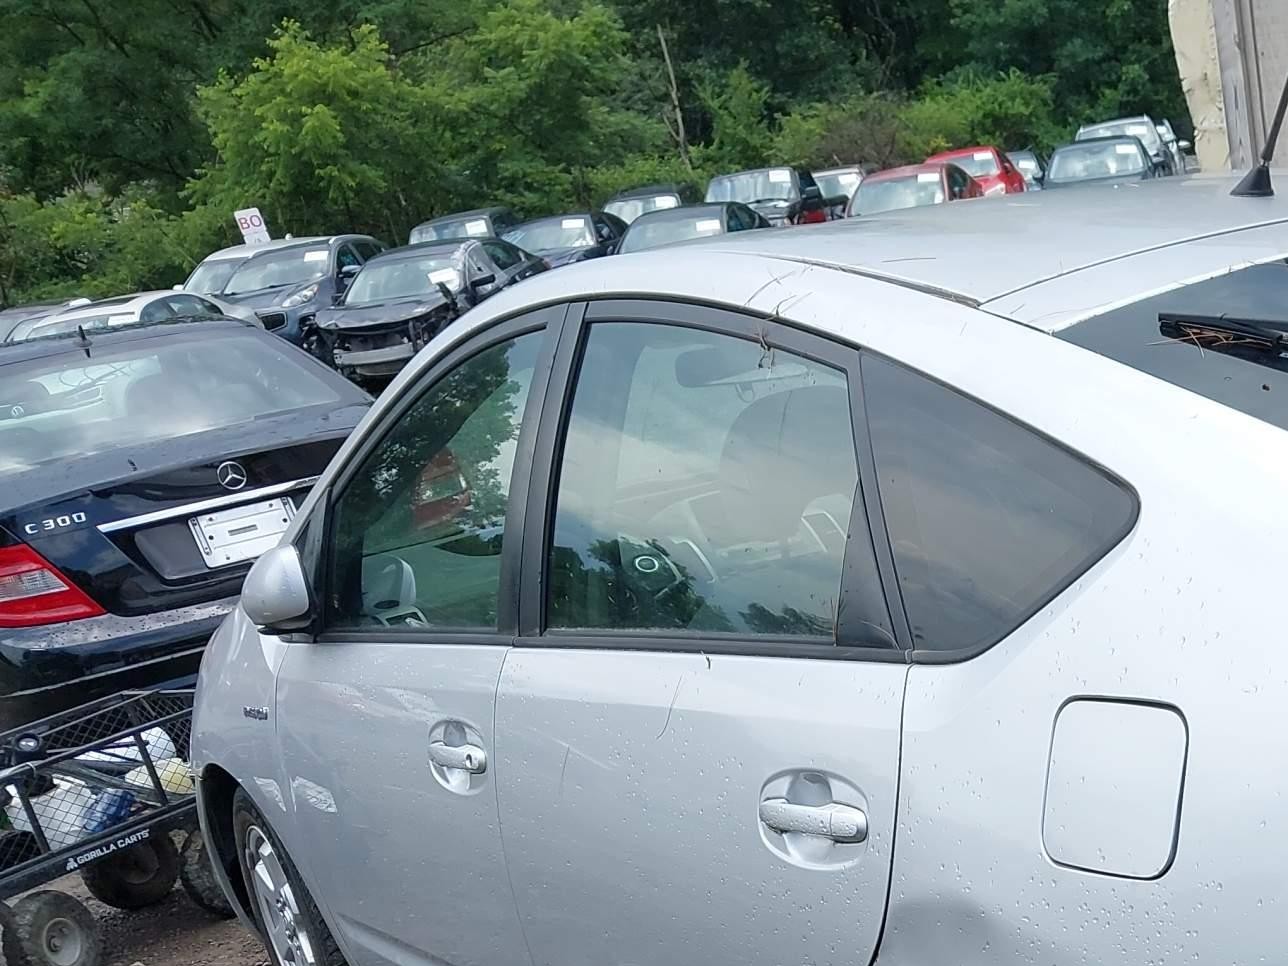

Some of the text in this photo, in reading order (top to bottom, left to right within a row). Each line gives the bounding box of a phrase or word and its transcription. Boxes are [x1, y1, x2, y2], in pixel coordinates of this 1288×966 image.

[24, 512, 87, 535] C 300
[76, 828, 150, 864] GORILLA CARTS
